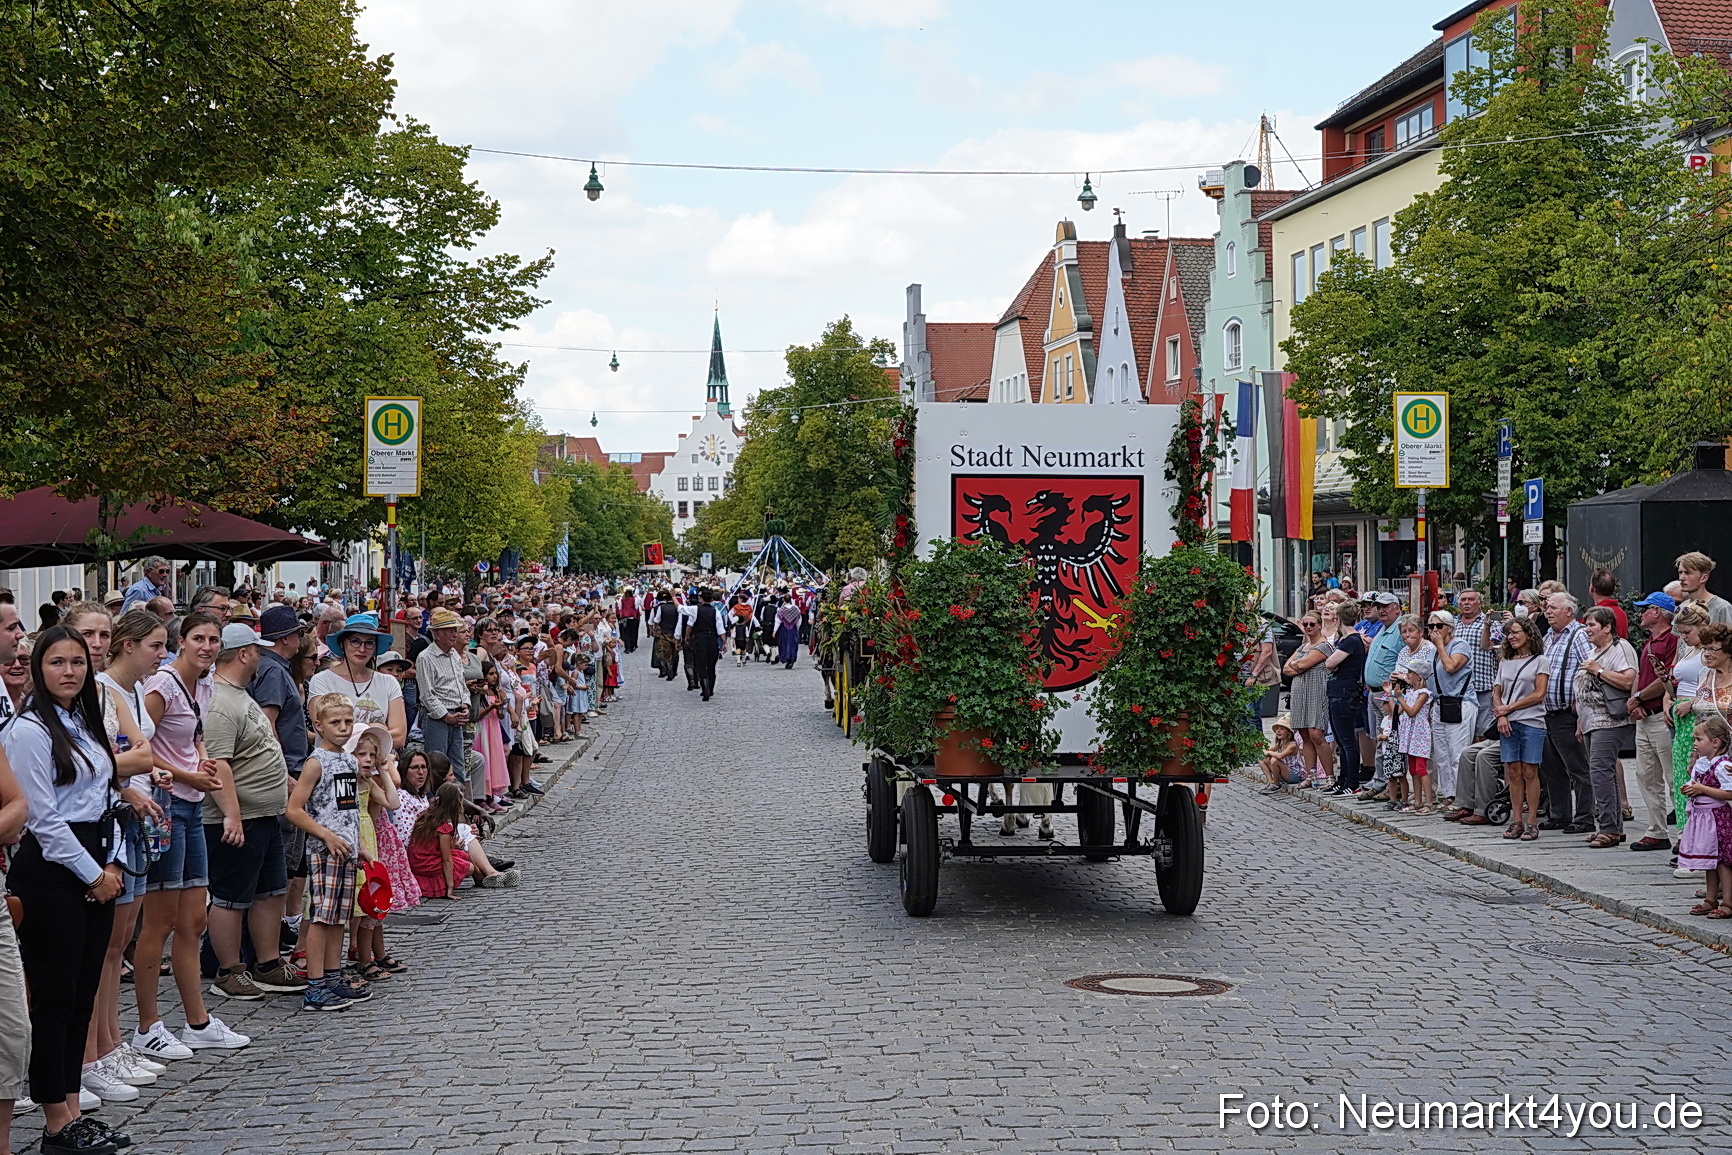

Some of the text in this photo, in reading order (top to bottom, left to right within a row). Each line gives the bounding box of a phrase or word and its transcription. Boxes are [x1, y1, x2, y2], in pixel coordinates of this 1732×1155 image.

[385, 412, 402, 436] H
[1413, 407, 1430, 430] H
[1500, 423, 1509, 454] P
[950, 444, 1145, 468] Stadt Neumarkt
[1528, 484, 1539, 516] P
